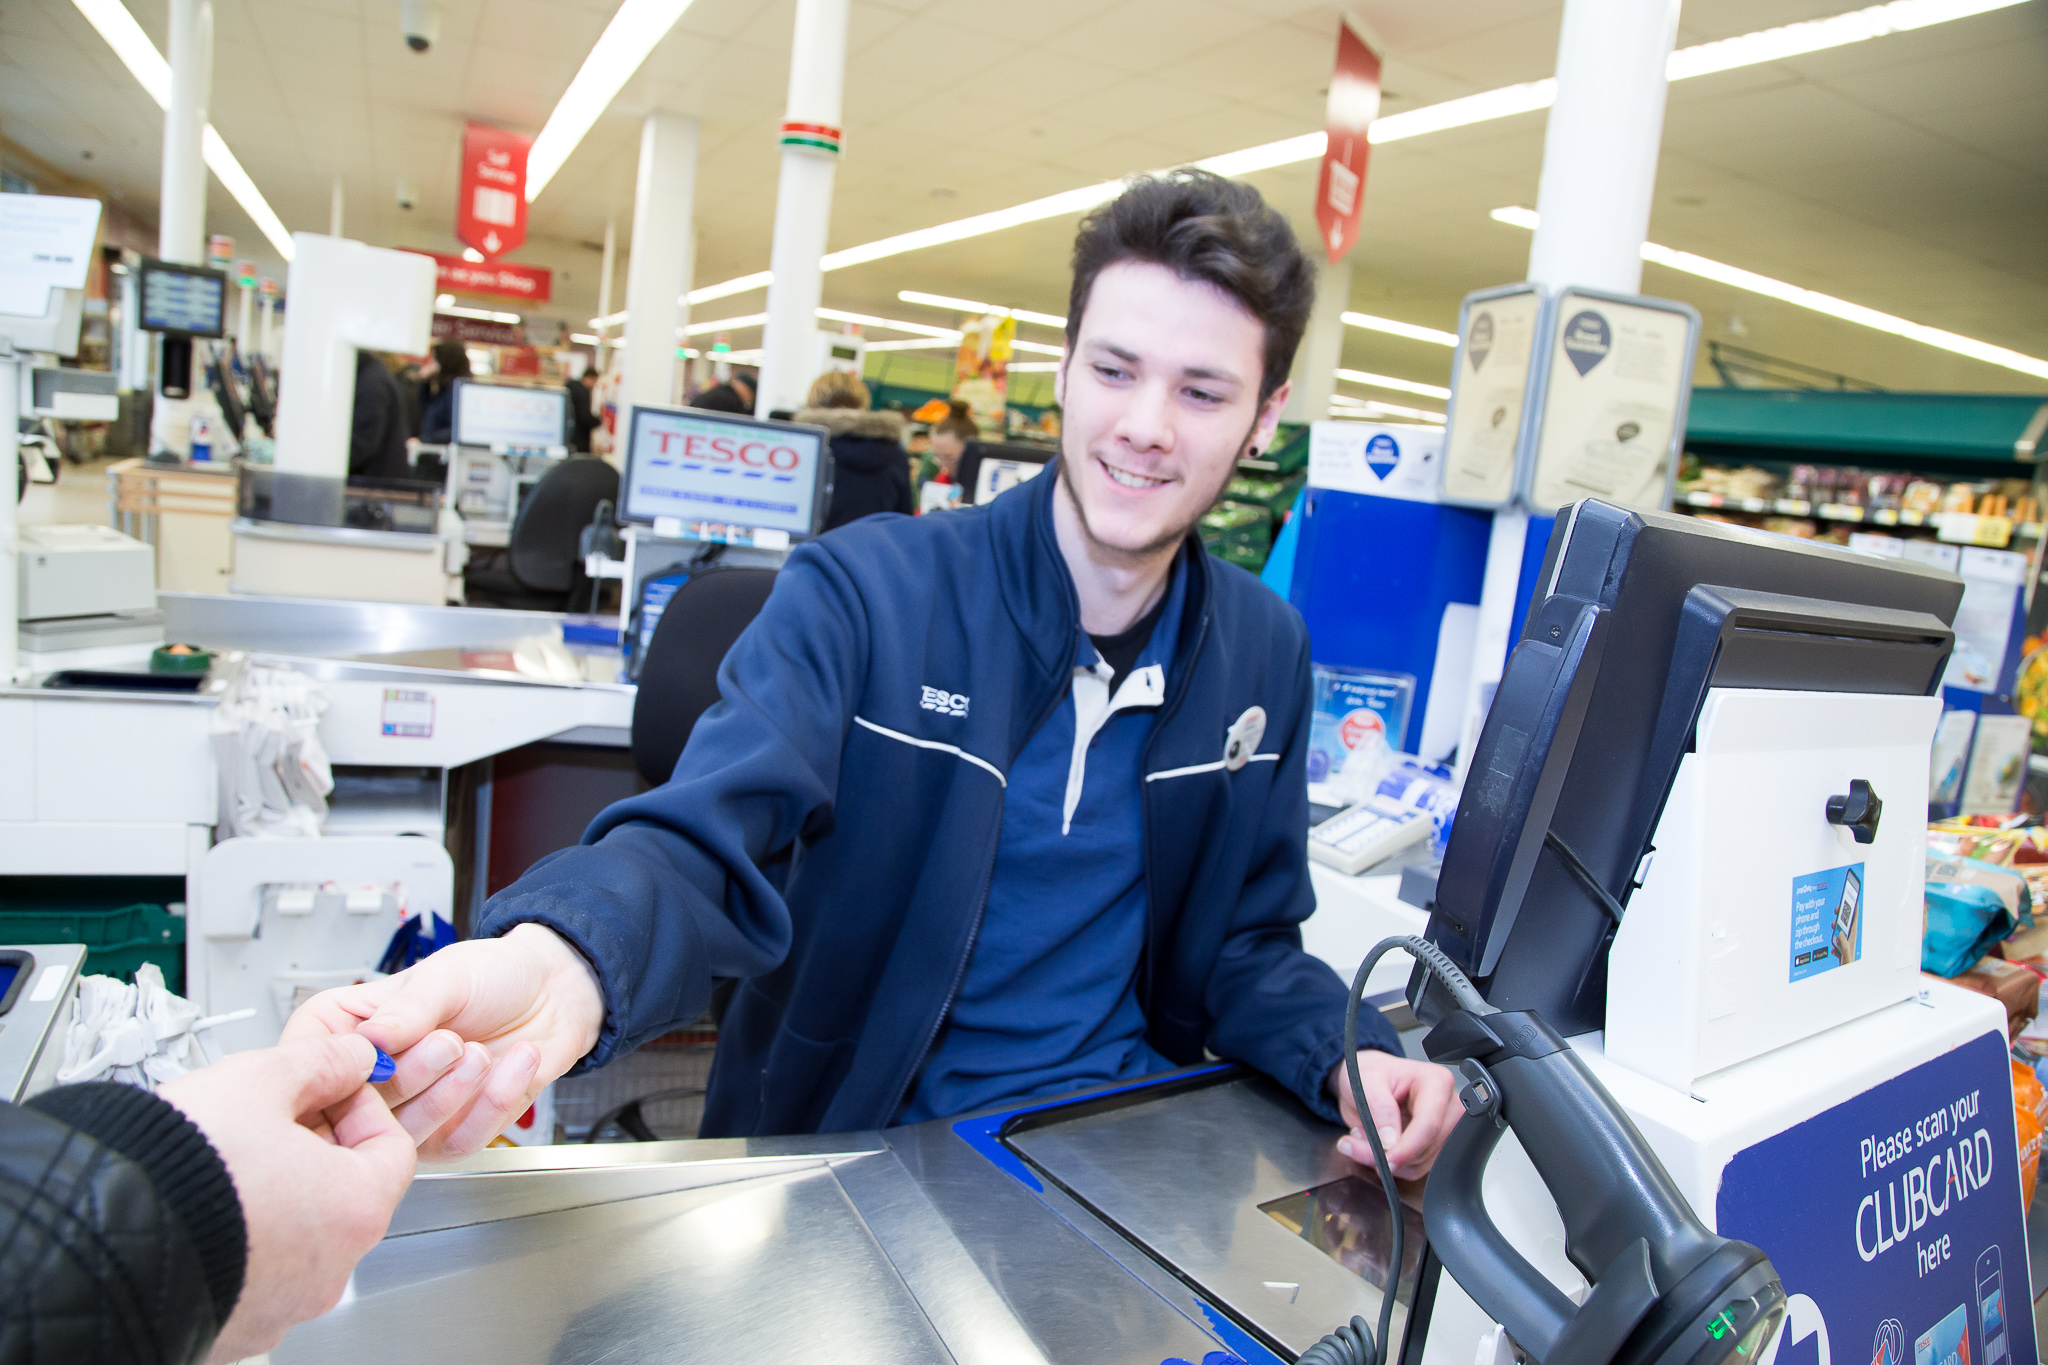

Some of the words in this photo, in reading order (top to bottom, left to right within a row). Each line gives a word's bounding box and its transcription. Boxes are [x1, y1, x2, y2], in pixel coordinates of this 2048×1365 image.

[650, 430, 799, 471] TESCO
[1796, 901, 1804, 913] Pay
[1805, 898, 1815, 910] with
[1815, 898, 1826, 910] your
[1796, 913, 1810, 926] phone
[1810, 909, 1820, 921] and
[1802, 921, 1820, 935] through
[1860, 1126, 1913, 1179] Please
[1915, 1107, 1949, 1148] scan
[1950, 1089, 1980, 1137] your
[1855, 1127, 1993, 1263] CLUBCARD
[1916, 1233, 1951, 1278] here
